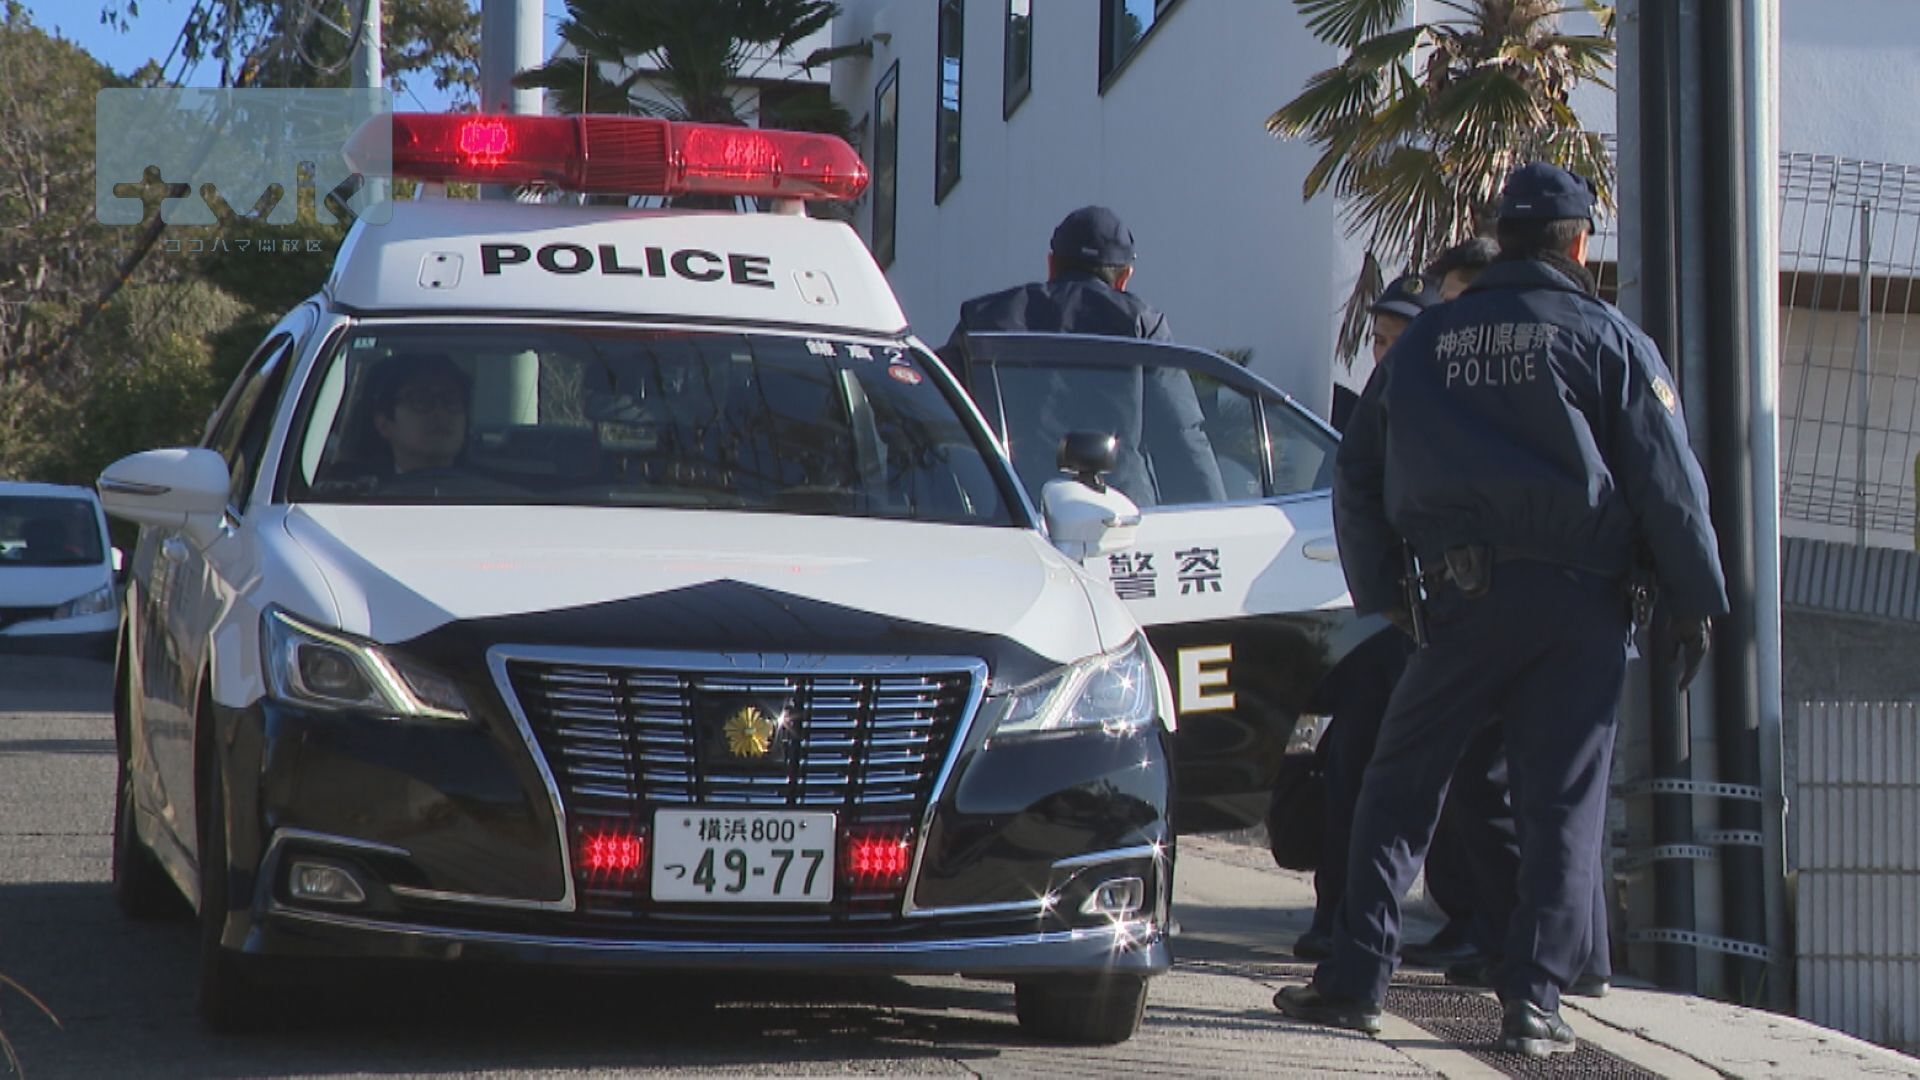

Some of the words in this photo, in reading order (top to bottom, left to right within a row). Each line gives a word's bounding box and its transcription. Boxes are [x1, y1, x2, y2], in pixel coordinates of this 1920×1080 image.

[480, 243, 776, 289] POLICE
[1446, 354, 1536, 388] POLICE
[1109, 547, 1222, 600] 警察
[692, 848, 824, 895] 49-77
